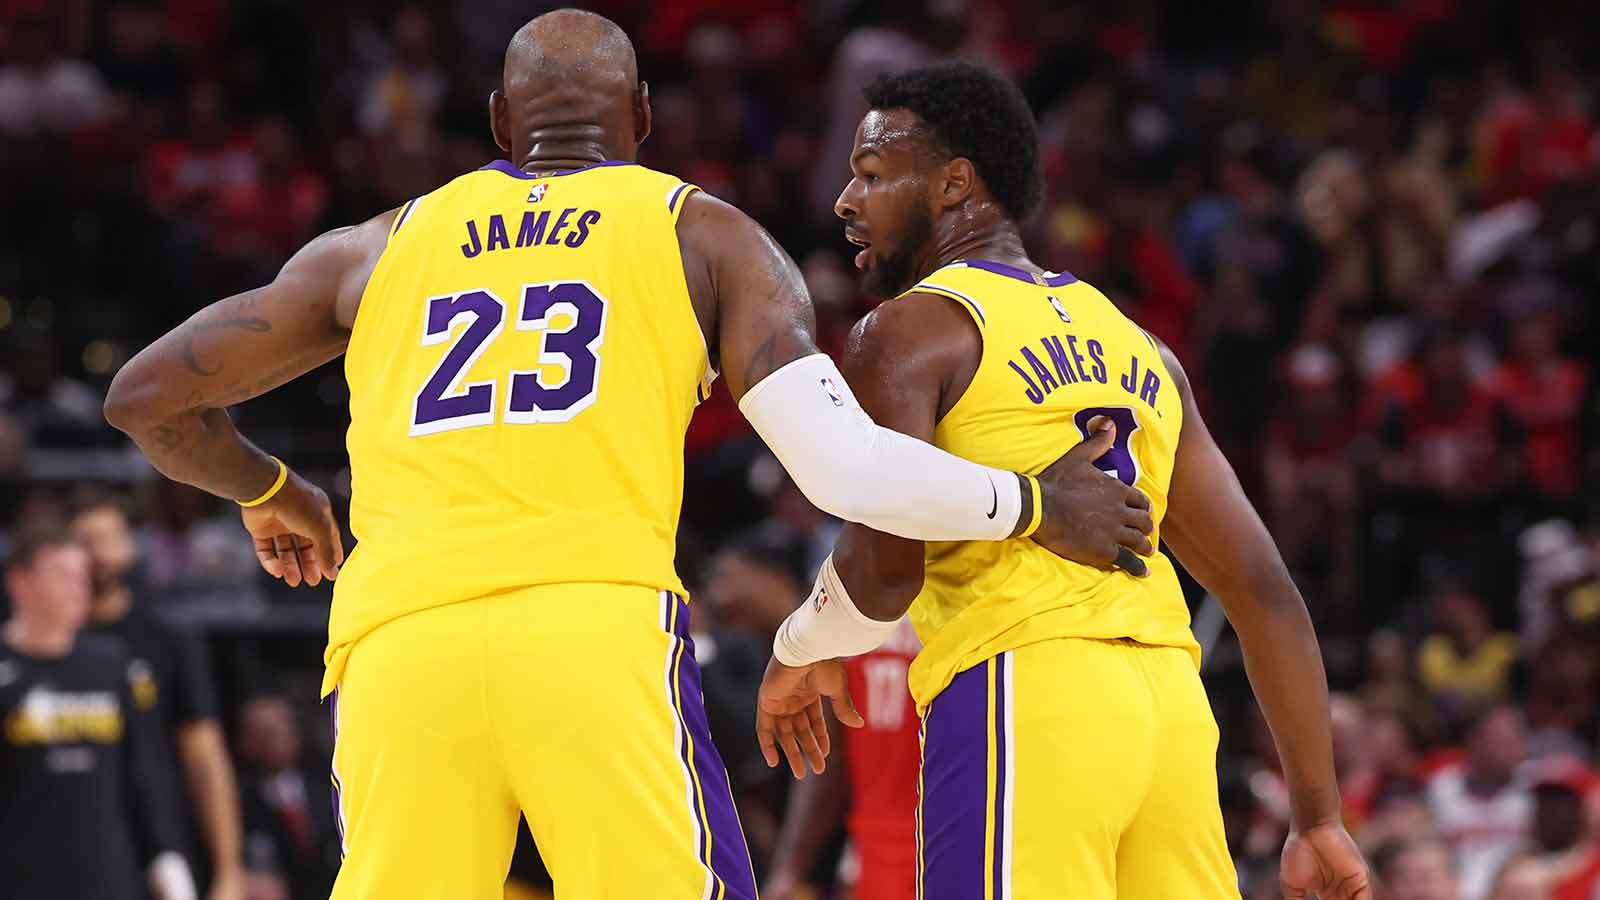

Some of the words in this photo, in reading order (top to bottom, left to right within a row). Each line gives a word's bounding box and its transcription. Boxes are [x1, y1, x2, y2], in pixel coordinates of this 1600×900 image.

[461, 208, 601, 258] JAMES
[408, 279, 608, 437] 23
[1008, 334, 1108, 405] JAMES
[1121, 355, 1162, 419] JR.
